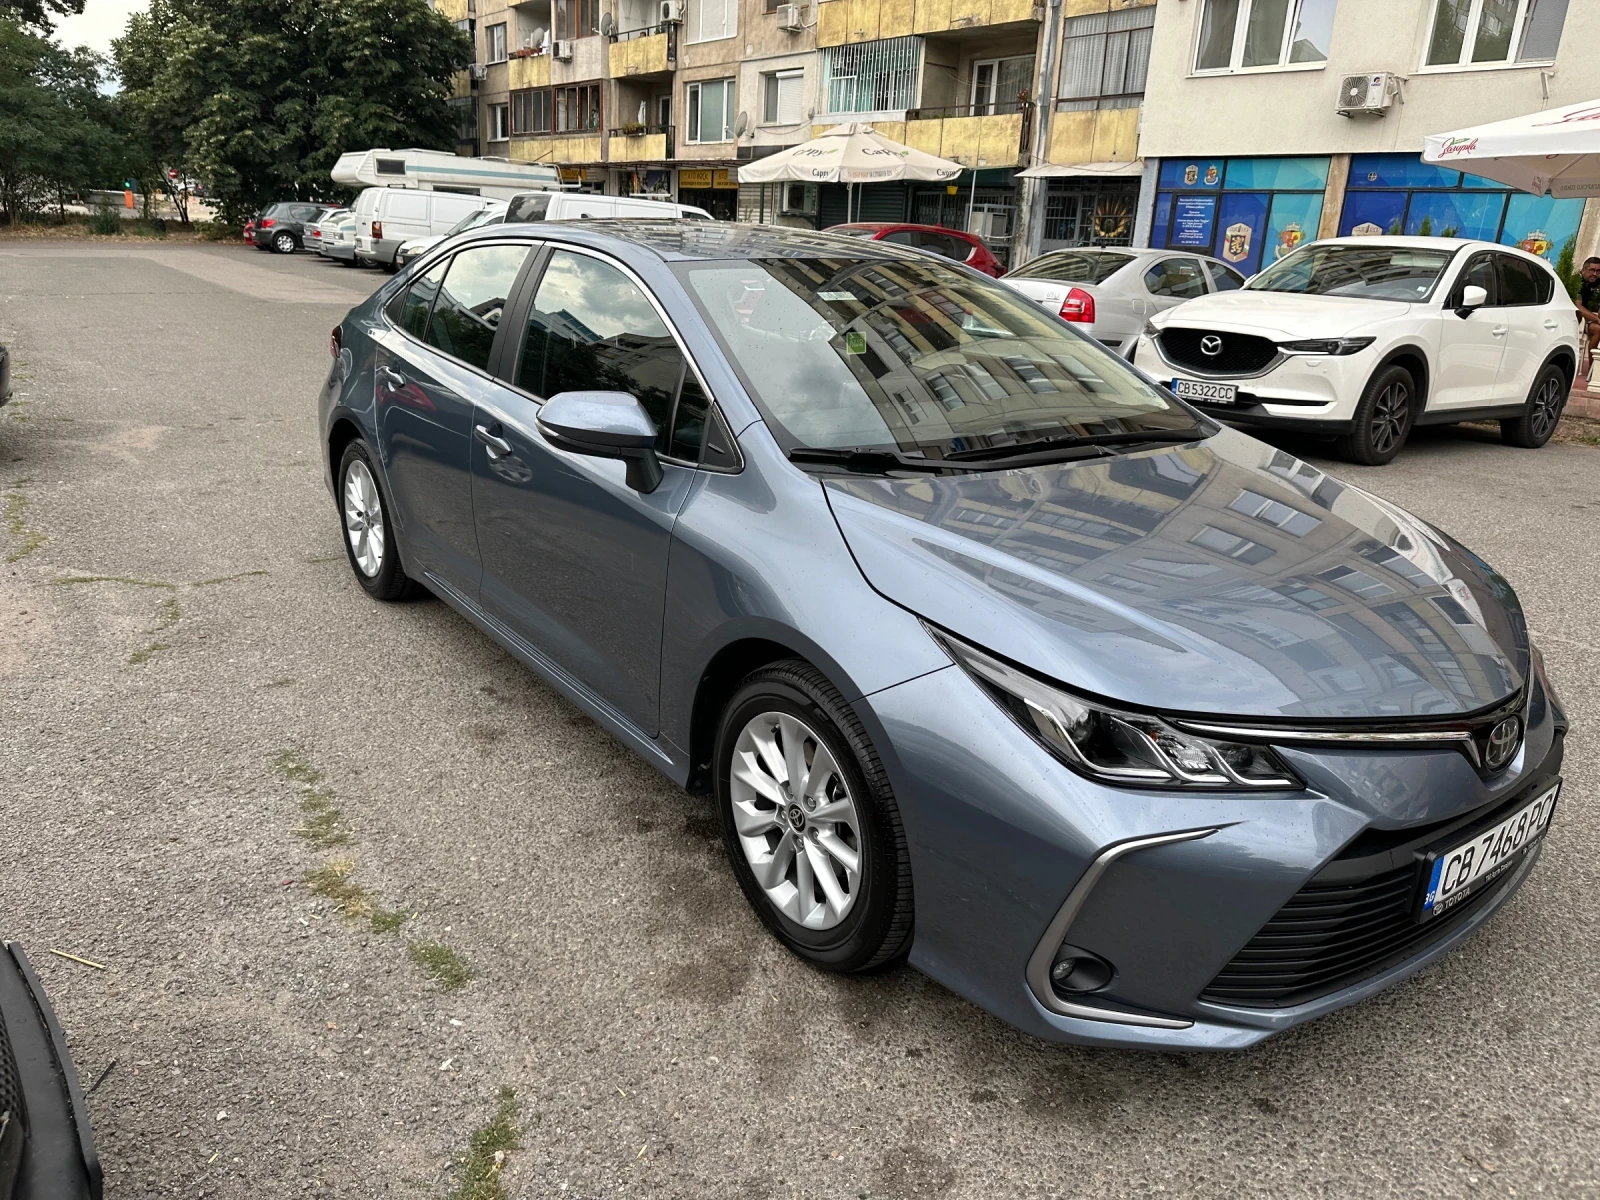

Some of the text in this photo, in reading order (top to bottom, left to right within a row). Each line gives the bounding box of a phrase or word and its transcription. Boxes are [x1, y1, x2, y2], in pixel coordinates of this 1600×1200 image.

[812, 167, 830, 179] Cappy
[1177, 382, 1233, 399] CB 5322 CC
[1441, 845, 1475, 896] CB
[1474, 812, 1528, 878] 7468
[1524, 793, 1553, 842] PC
[1445, 886, 1470, 909] TOYOTA
